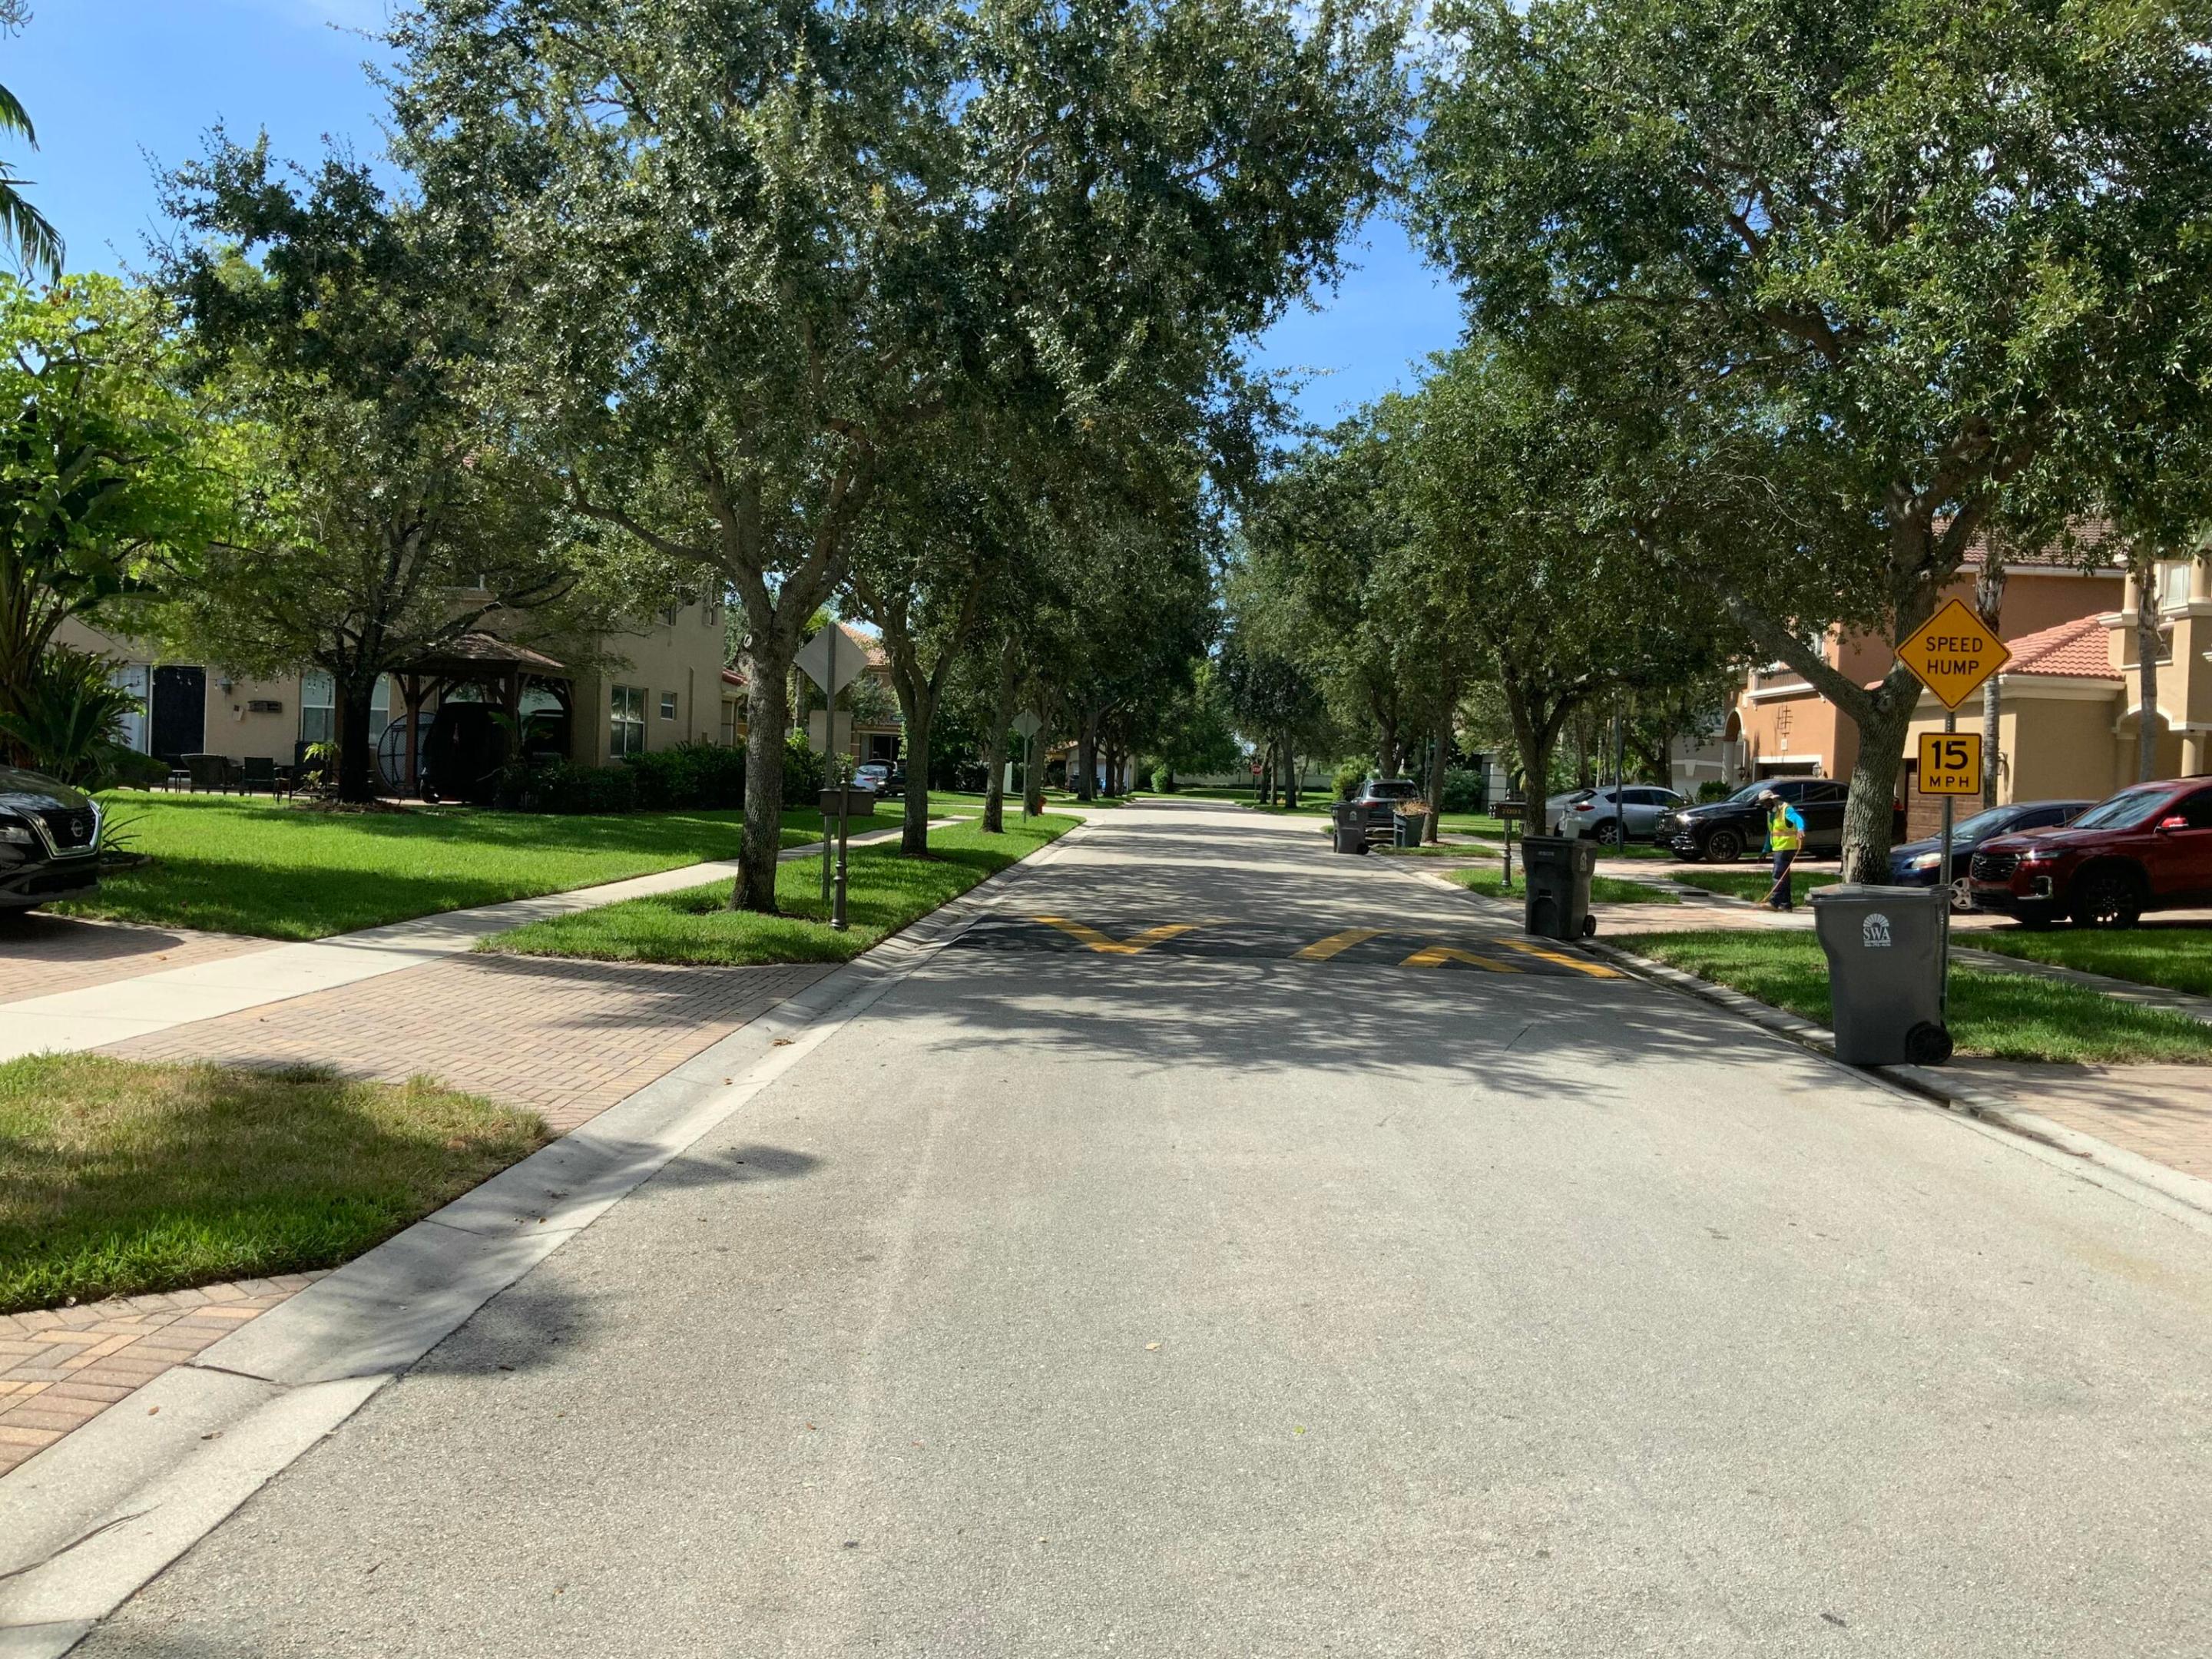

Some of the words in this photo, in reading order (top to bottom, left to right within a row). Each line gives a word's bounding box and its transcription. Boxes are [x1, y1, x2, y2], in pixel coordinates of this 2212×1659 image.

[1926, 637, 1983, 653] SPEED
[1927, 660, 1979, 675] HUMP
[1931, 740, 1969, 770] 15
[1929, 775, 1969, 787] MPH
[1863, 926, 1891, 940] SWA
